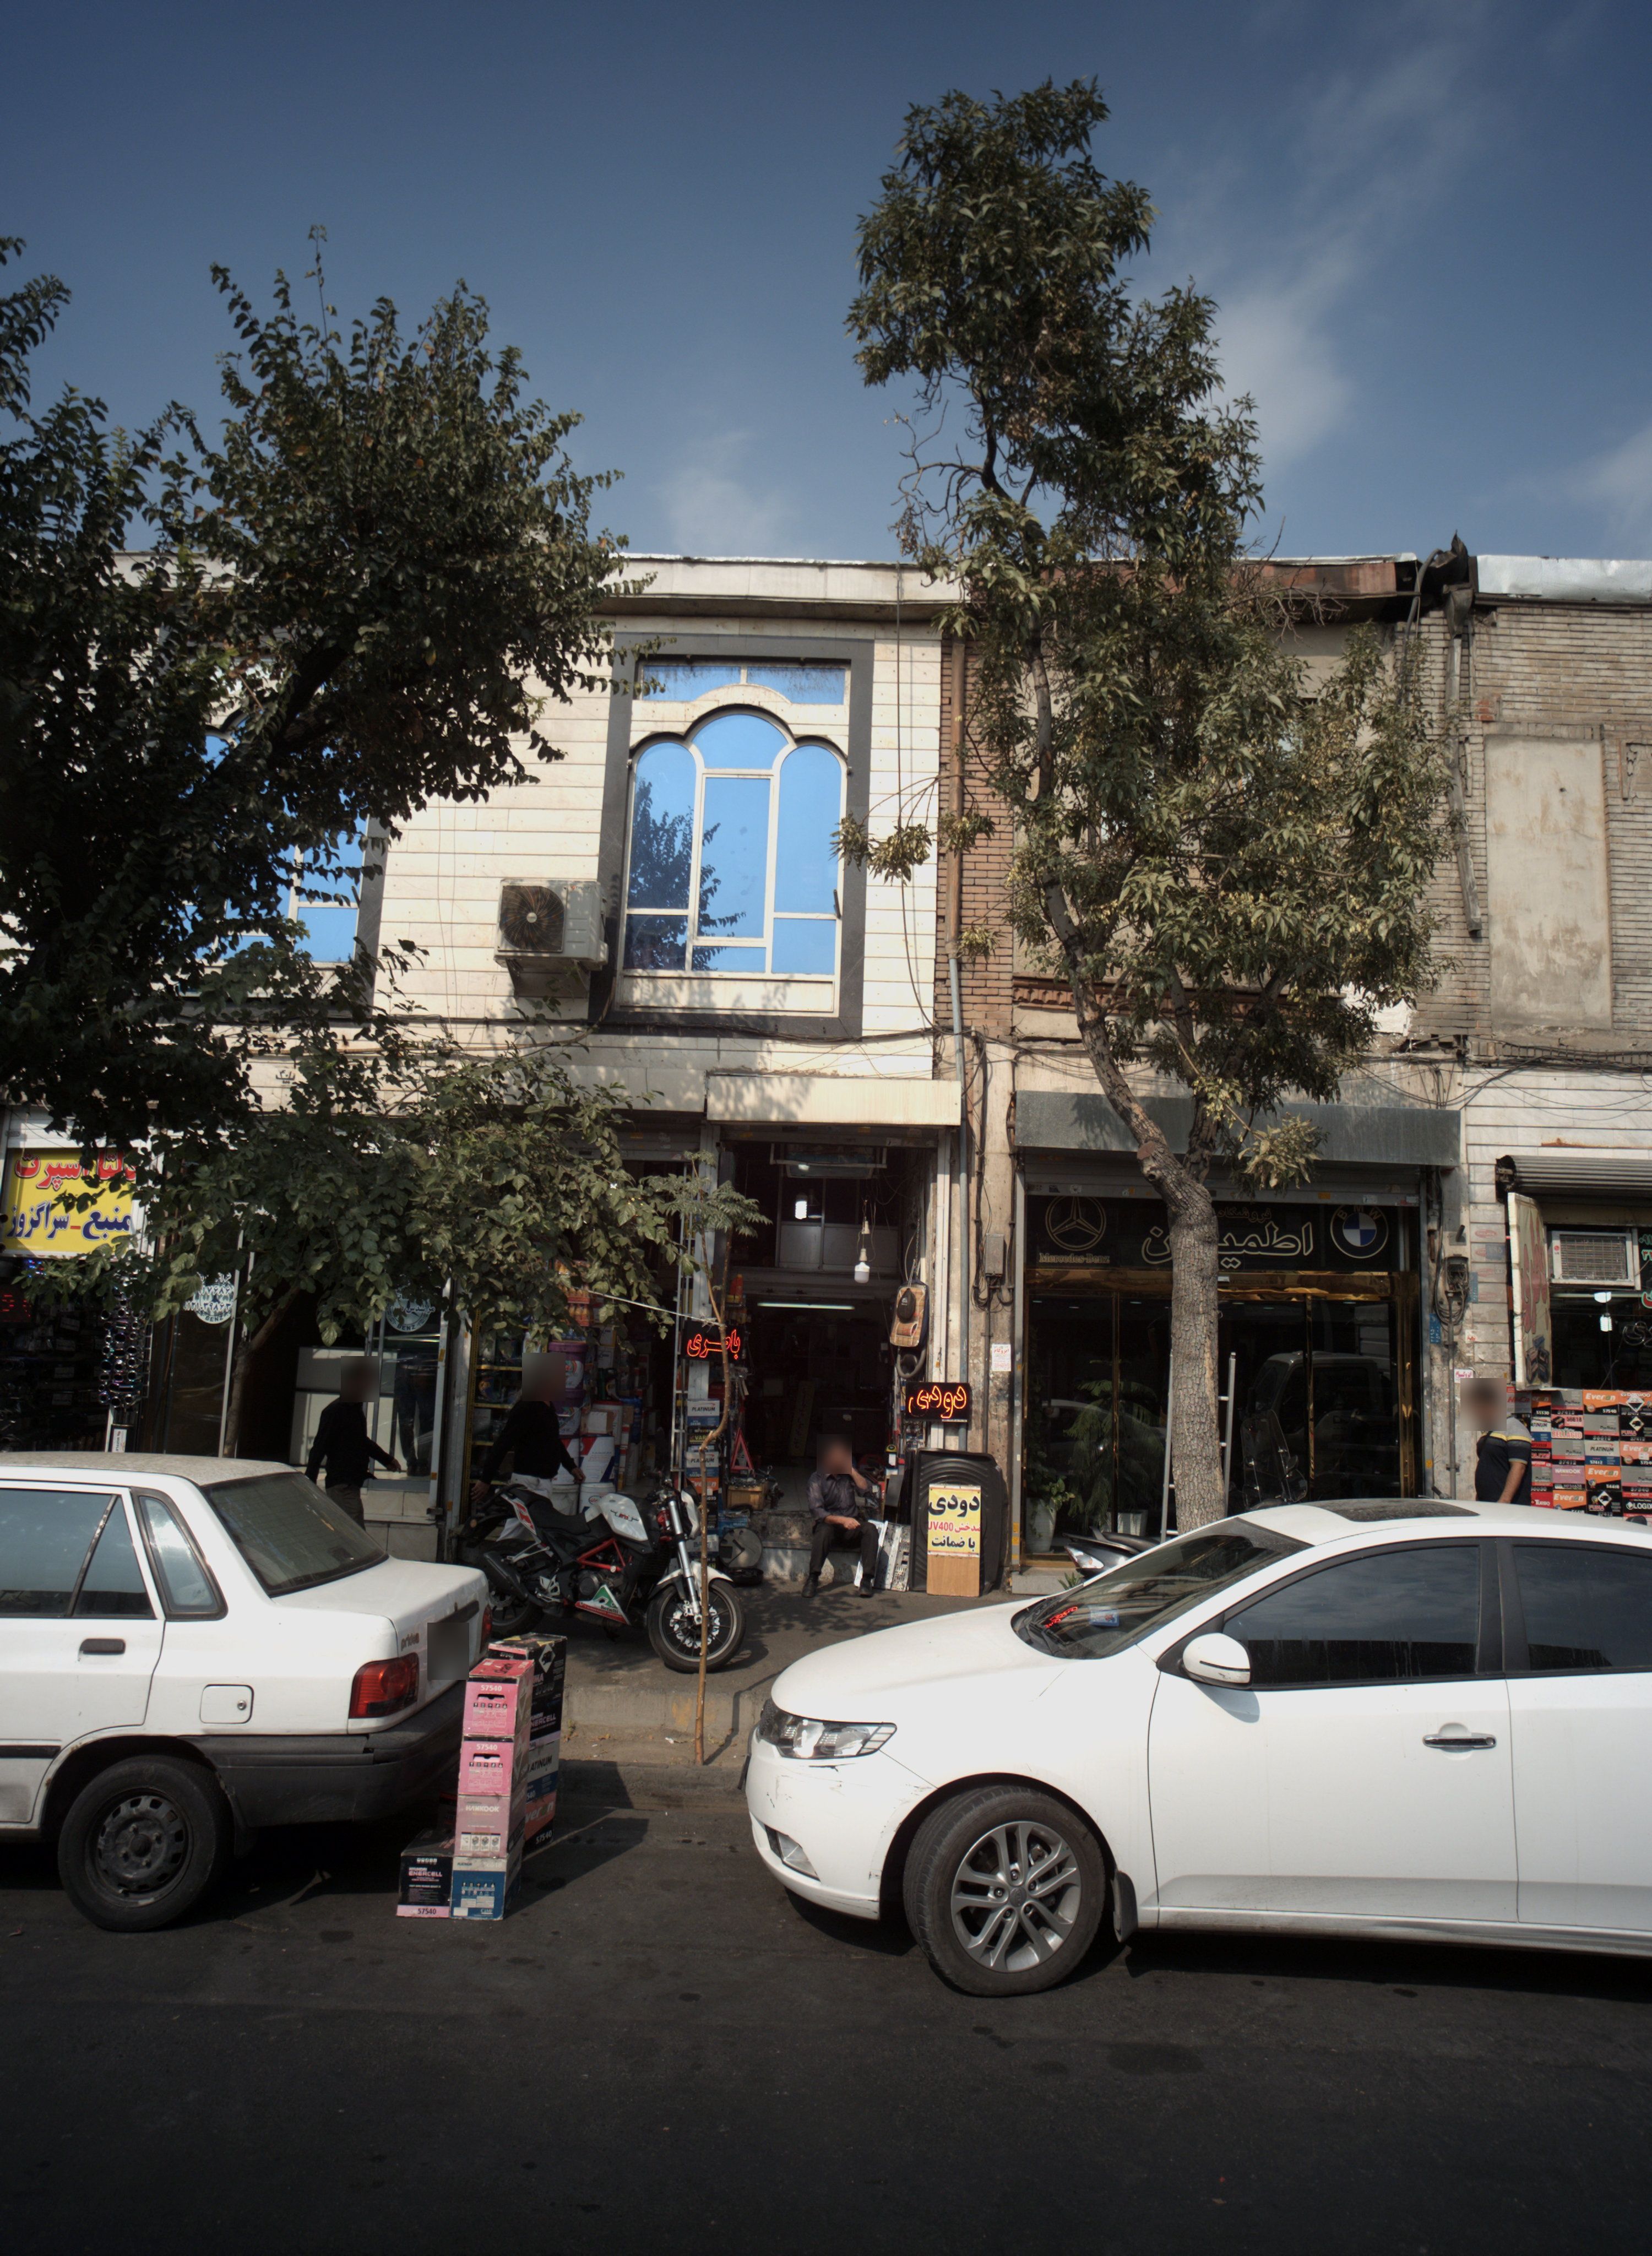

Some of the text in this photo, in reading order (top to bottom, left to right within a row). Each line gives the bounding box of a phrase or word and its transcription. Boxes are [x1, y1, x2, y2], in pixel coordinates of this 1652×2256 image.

[15, 1153, 90, 1191] سپرت
[1338, 1202, 1381, 1221] BMW
[83, 1206, 132, 1241] منبع
[1141, 1221, 1314, 1268] اطمین
[1039, 1252, 1110, 1264] Mercedes-Benz
[927, 1494, 980, 1518] دودی
[932, 1535, 976, 1552] با ضمانت
[528, 1755, 552, 1772] LATINUM
[525, 1801, 555, 1823] veron
